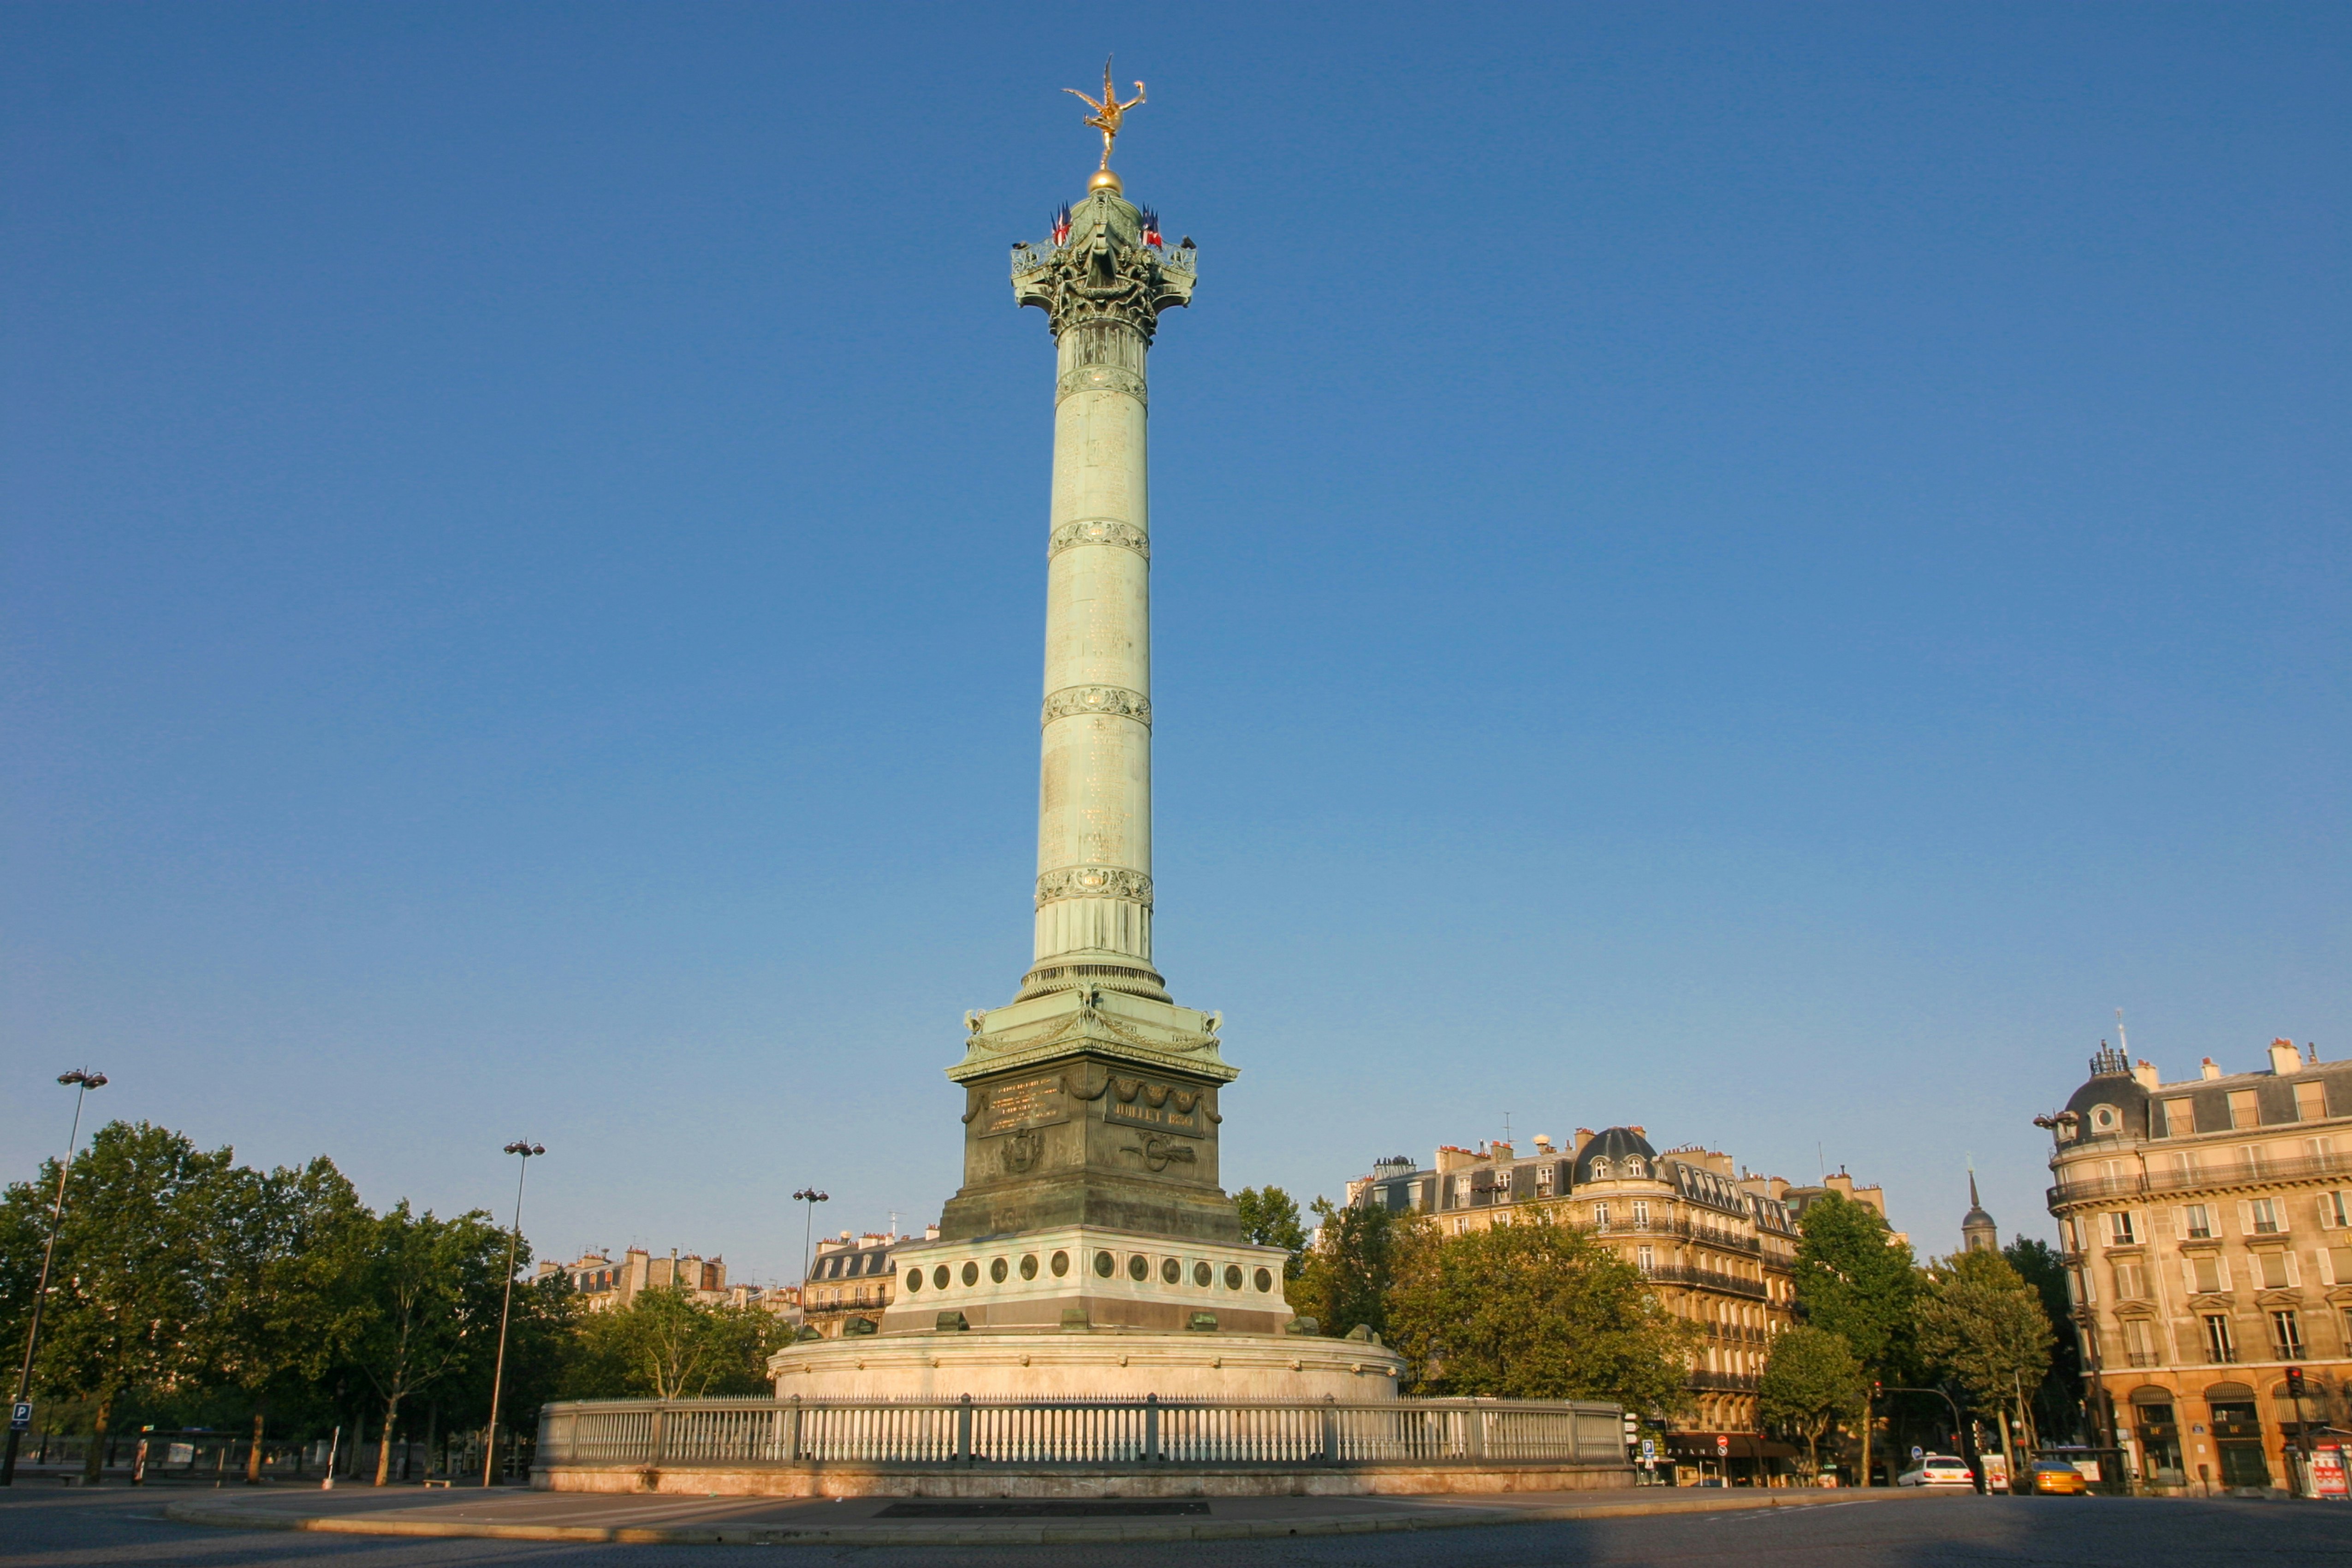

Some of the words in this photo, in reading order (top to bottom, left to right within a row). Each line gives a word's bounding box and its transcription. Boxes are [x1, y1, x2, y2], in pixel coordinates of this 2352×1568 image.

[1118, 1079, 1132, 1091] 27
[1148, 1085, 1161, 1098] 28
[1177, 1090, 1189, 1103] 29
[1115, 1103, 1163, 1123] JUILLET
[1168, 1112, 1194, 1127] 1830
[18, 1407, 26, 1417] P
[1645, 1442, 1651, 1451] P
